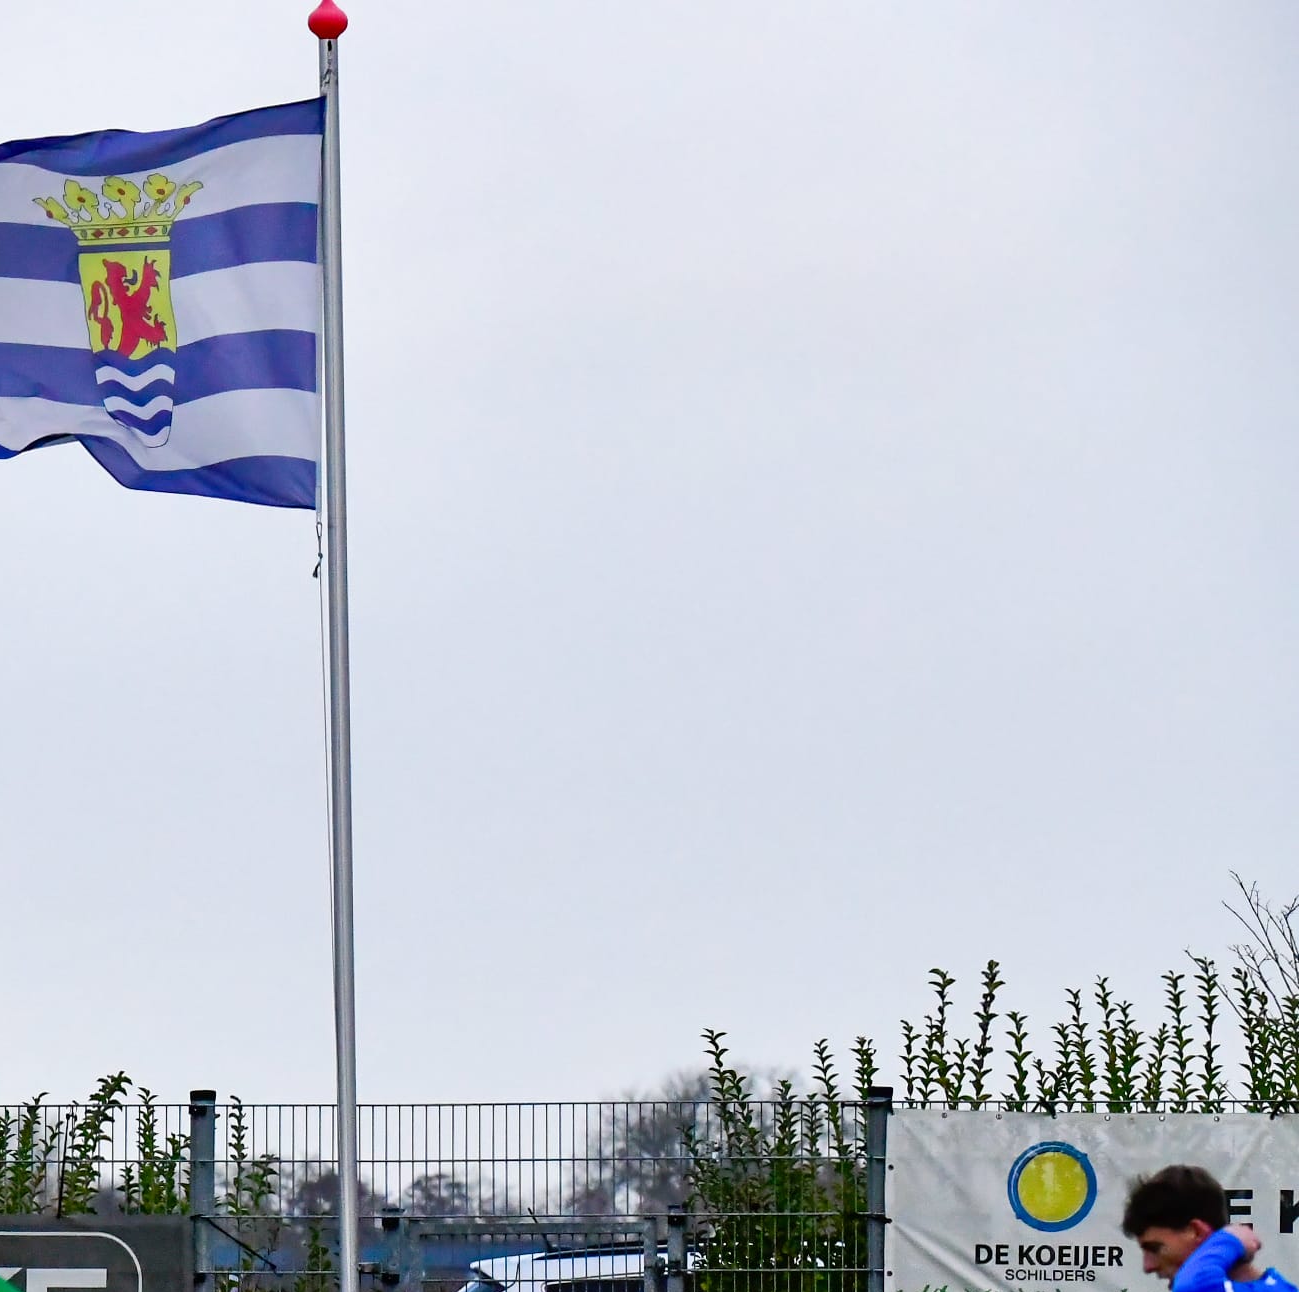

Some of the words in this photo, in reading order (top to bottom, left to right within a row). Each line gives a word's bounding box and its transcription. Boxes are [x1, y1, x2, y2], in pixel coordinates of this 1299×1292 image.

[975, 1244, 1009, 1265] DE
[1018, 1245, 1124, 1269] KOEIJER
[1005, 1269, 1096, 1282] SCHILDERS
